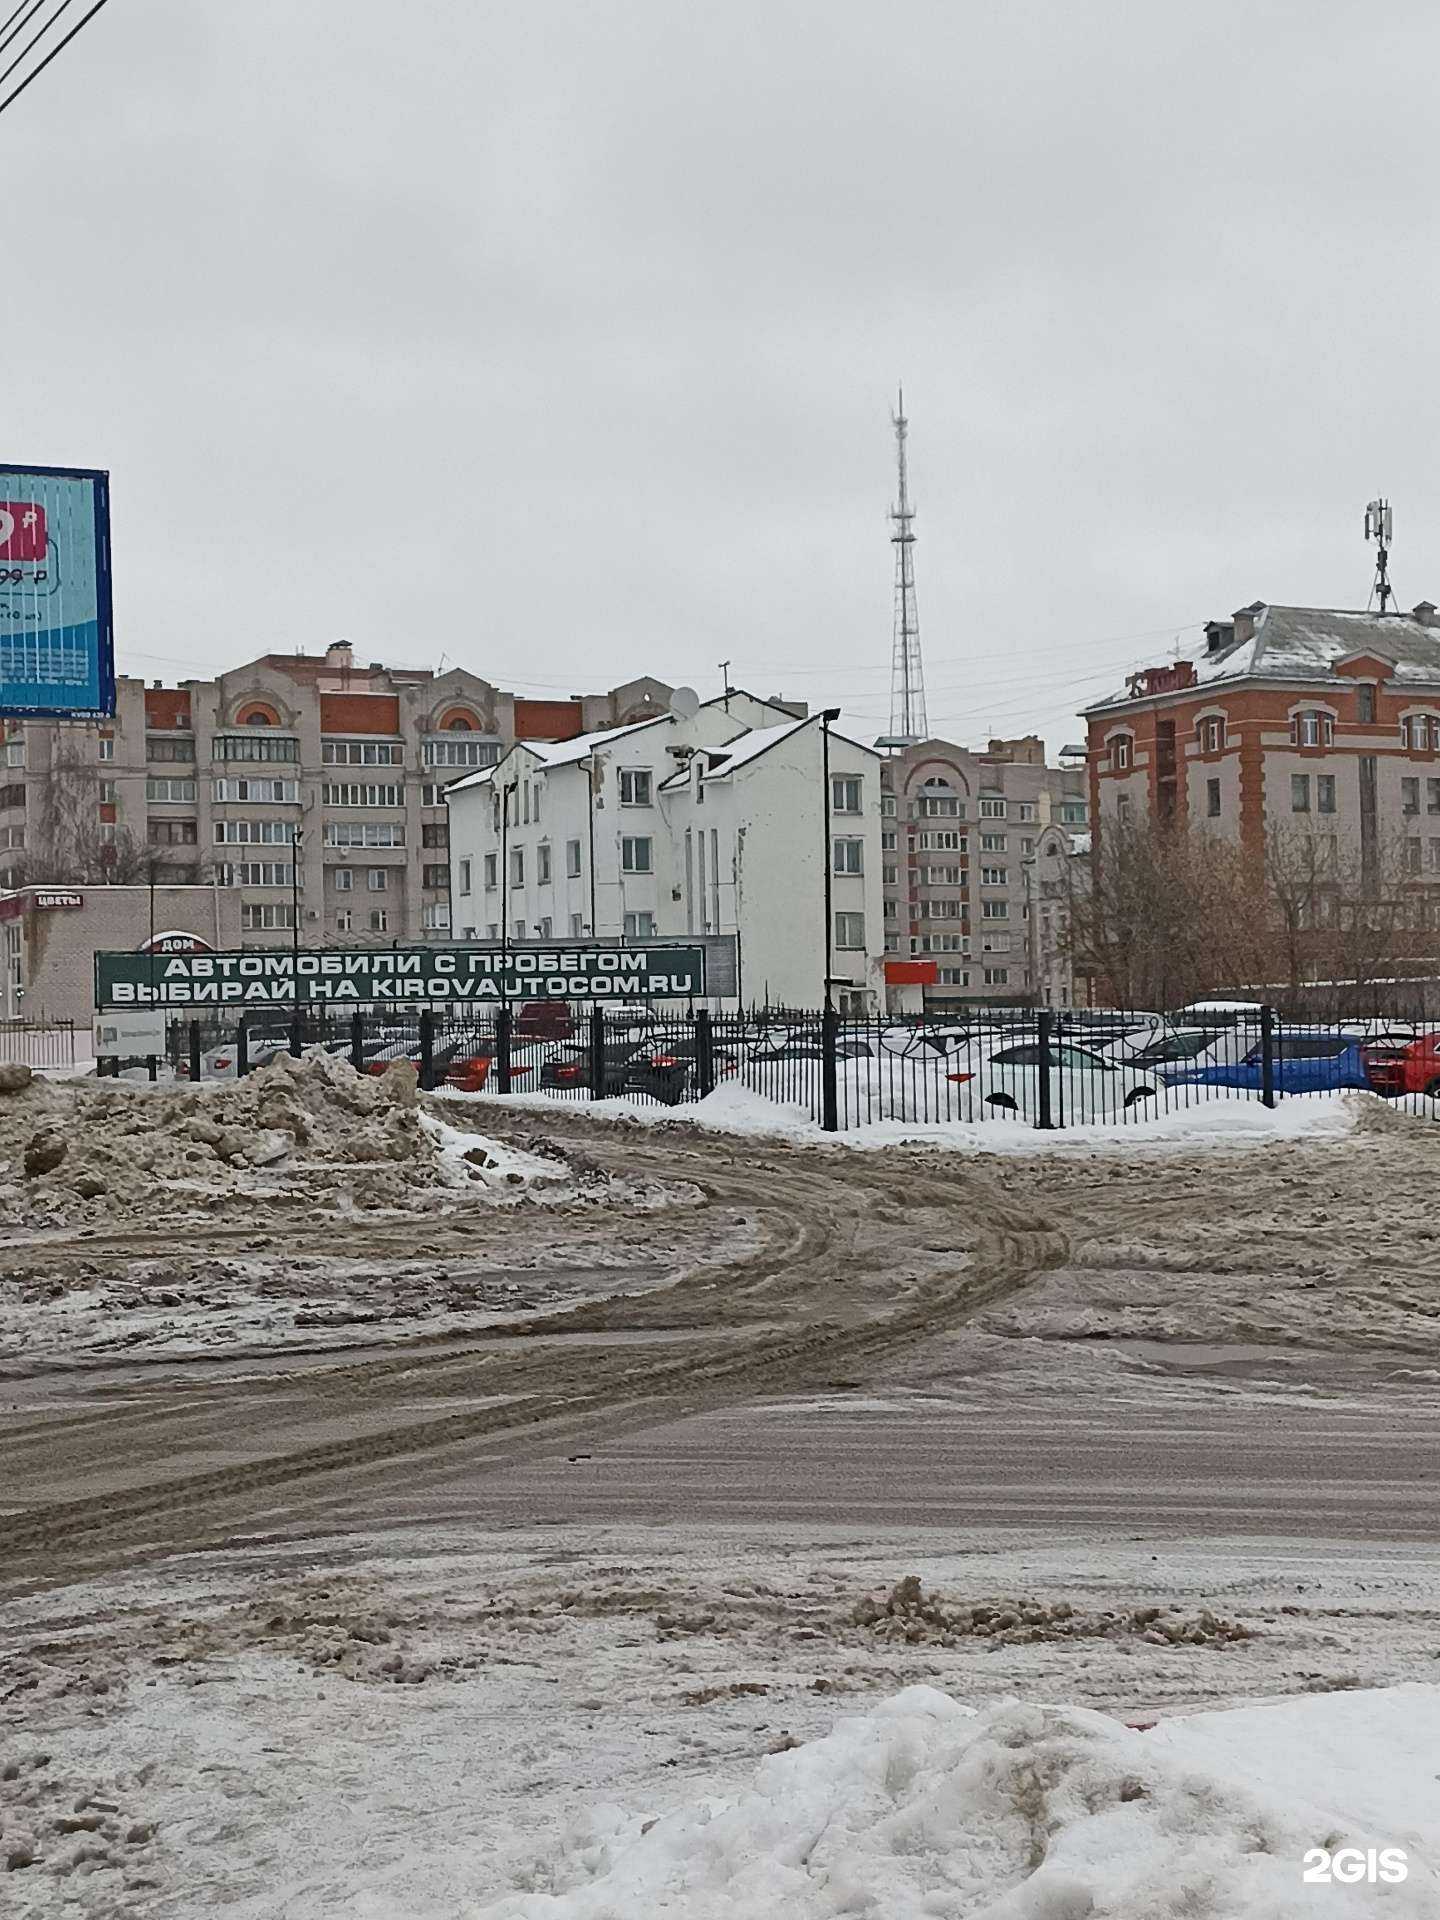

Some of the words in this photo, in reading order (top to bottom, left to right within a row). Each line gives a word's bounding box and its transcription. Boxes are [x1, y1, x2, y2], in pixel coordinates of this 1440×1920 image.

[38, 895, 81, 906] ЦВЕТЫ
[161, 938, 196, 952] ДОМ
[164, 955, 421, 977] АВТОМОБИЛИ
[434, 954, 456, 973] С
[468, 953, 648, 973] ПРОБЕГОМ
[111, 977, 296, 1002] ВЫБИРАЙ
[309, 979, 360, 998] НА
[372, 974, 693, 997] KIROVAUTOCOM.RU
